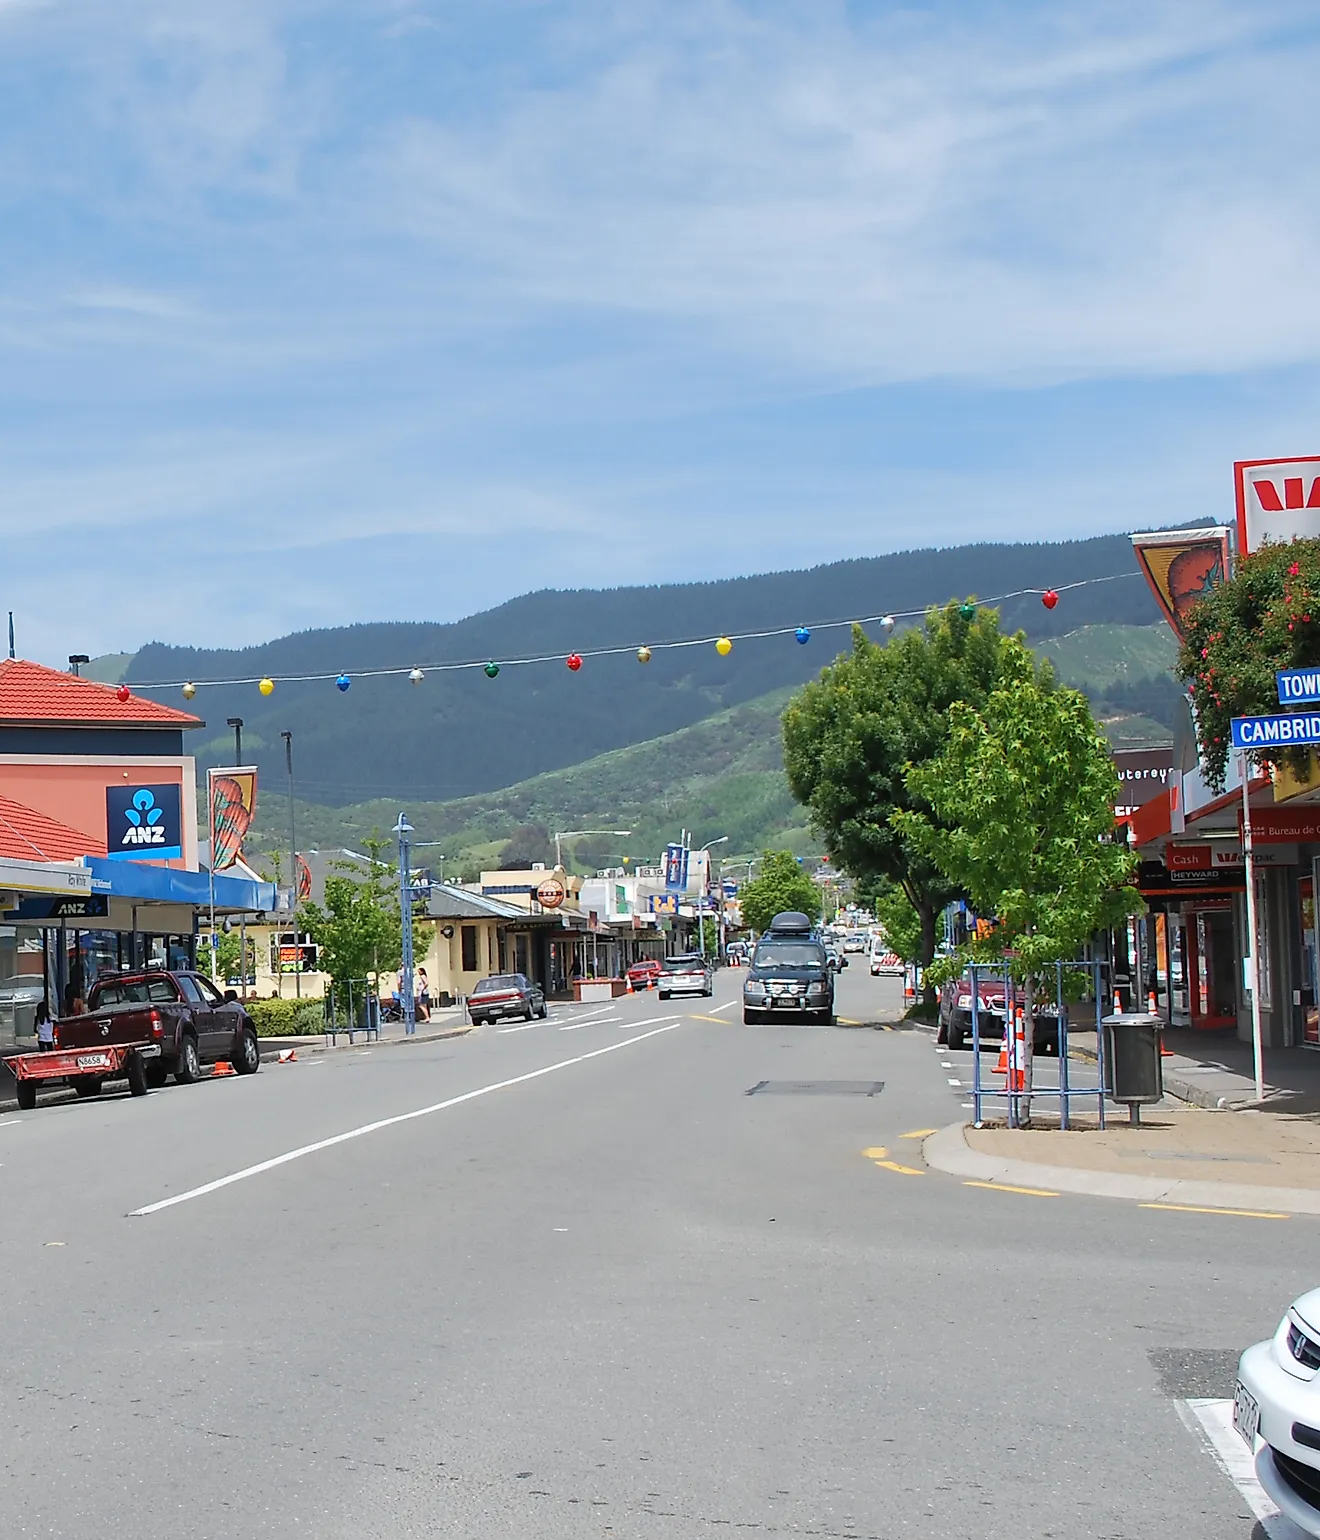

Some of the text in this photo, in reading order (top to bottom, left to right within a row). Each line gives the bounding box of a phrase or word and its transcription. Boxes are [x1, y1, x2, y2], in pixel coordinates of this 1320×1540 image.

[1281, 673, 1320, 697] TOW
[121, 826, 166, 844] ANZ
[1268, 826, 1301, 836] Bureau
[1302, 825, 1315, 835] de
[1172, 855, 1199, 865] Cash
[1216, 852, 1276, 863] Wepac
[1173, 870, 1219, 879] HEYWARD
[57, 903, 86, 915] ANZ
